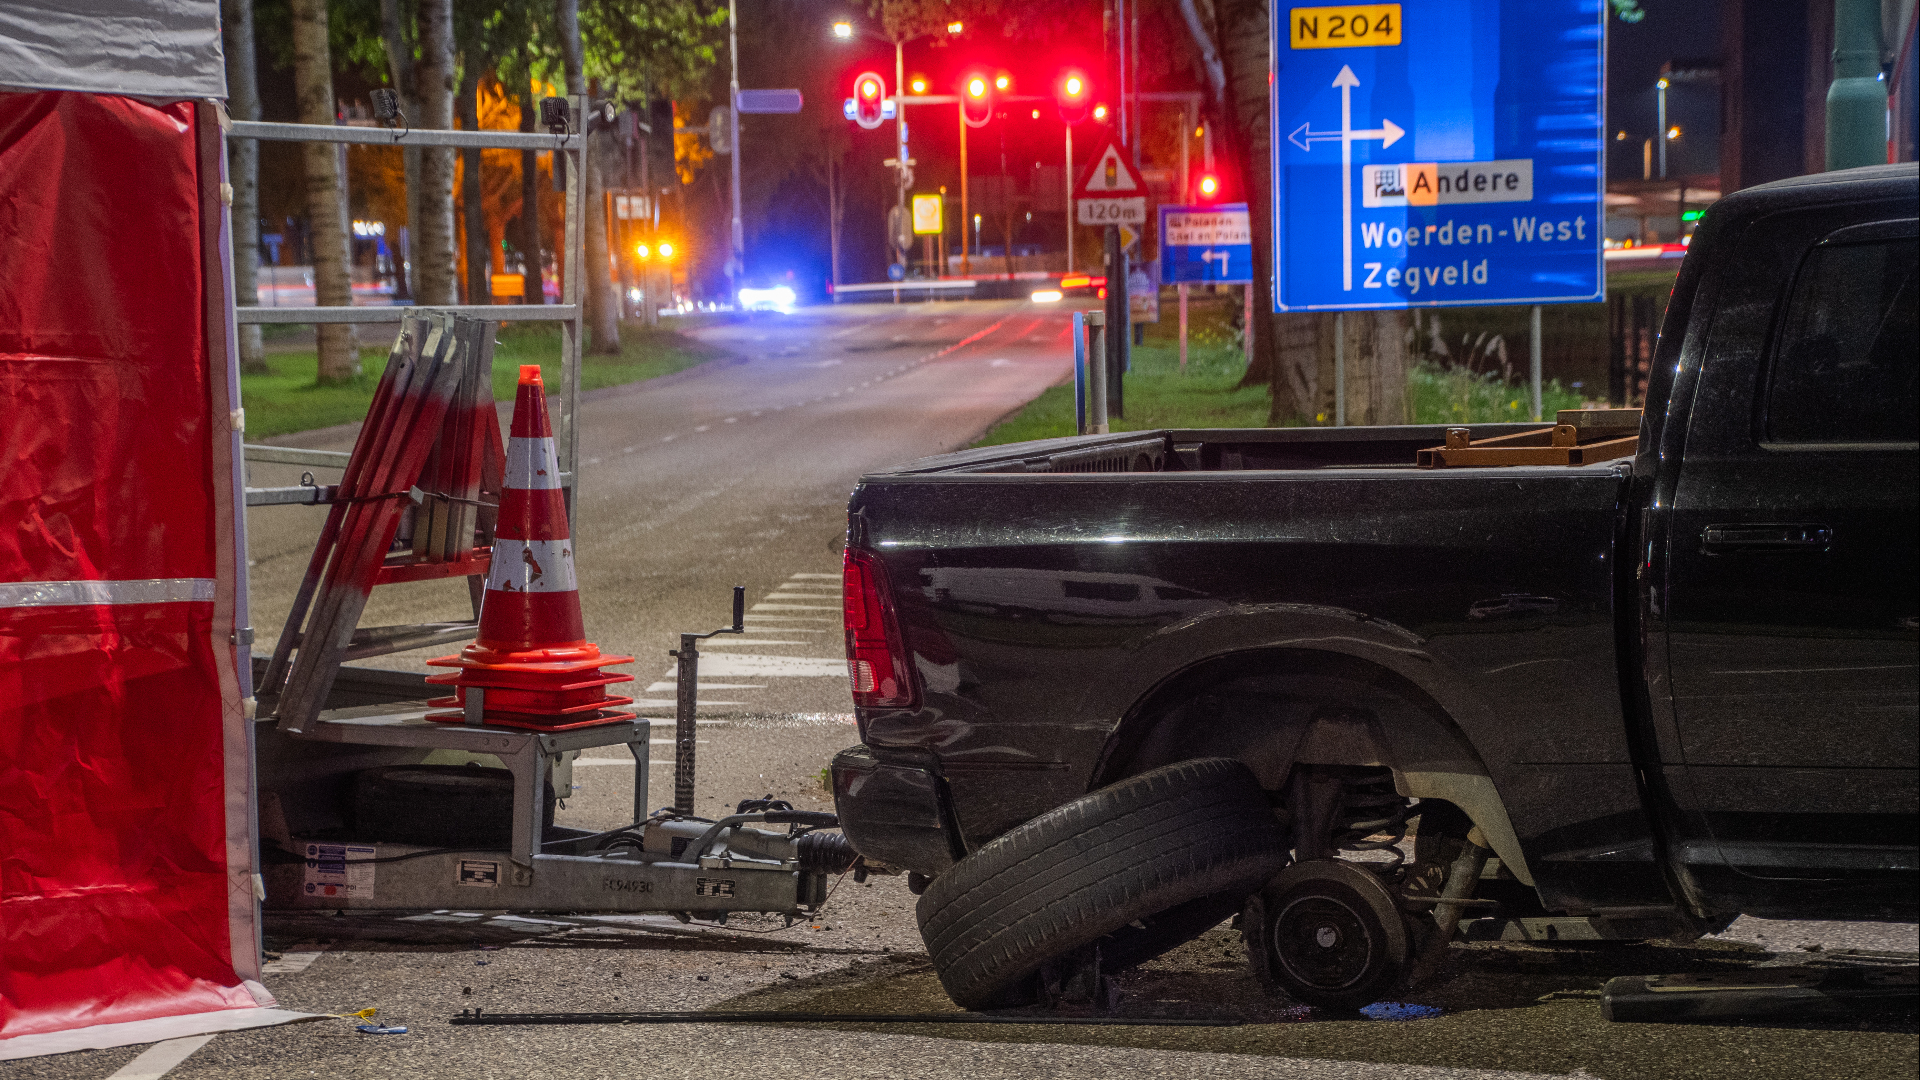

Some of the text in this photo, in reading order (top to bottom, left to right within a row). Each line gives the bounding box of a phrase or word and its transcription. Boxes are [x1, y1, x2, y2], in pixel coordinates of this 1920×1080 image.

[1411, 169, 1519, 194] Andere
[1361, 215, 1587, 249] Woerden-West
[1362, 259, 1488, 295] Zegveld
